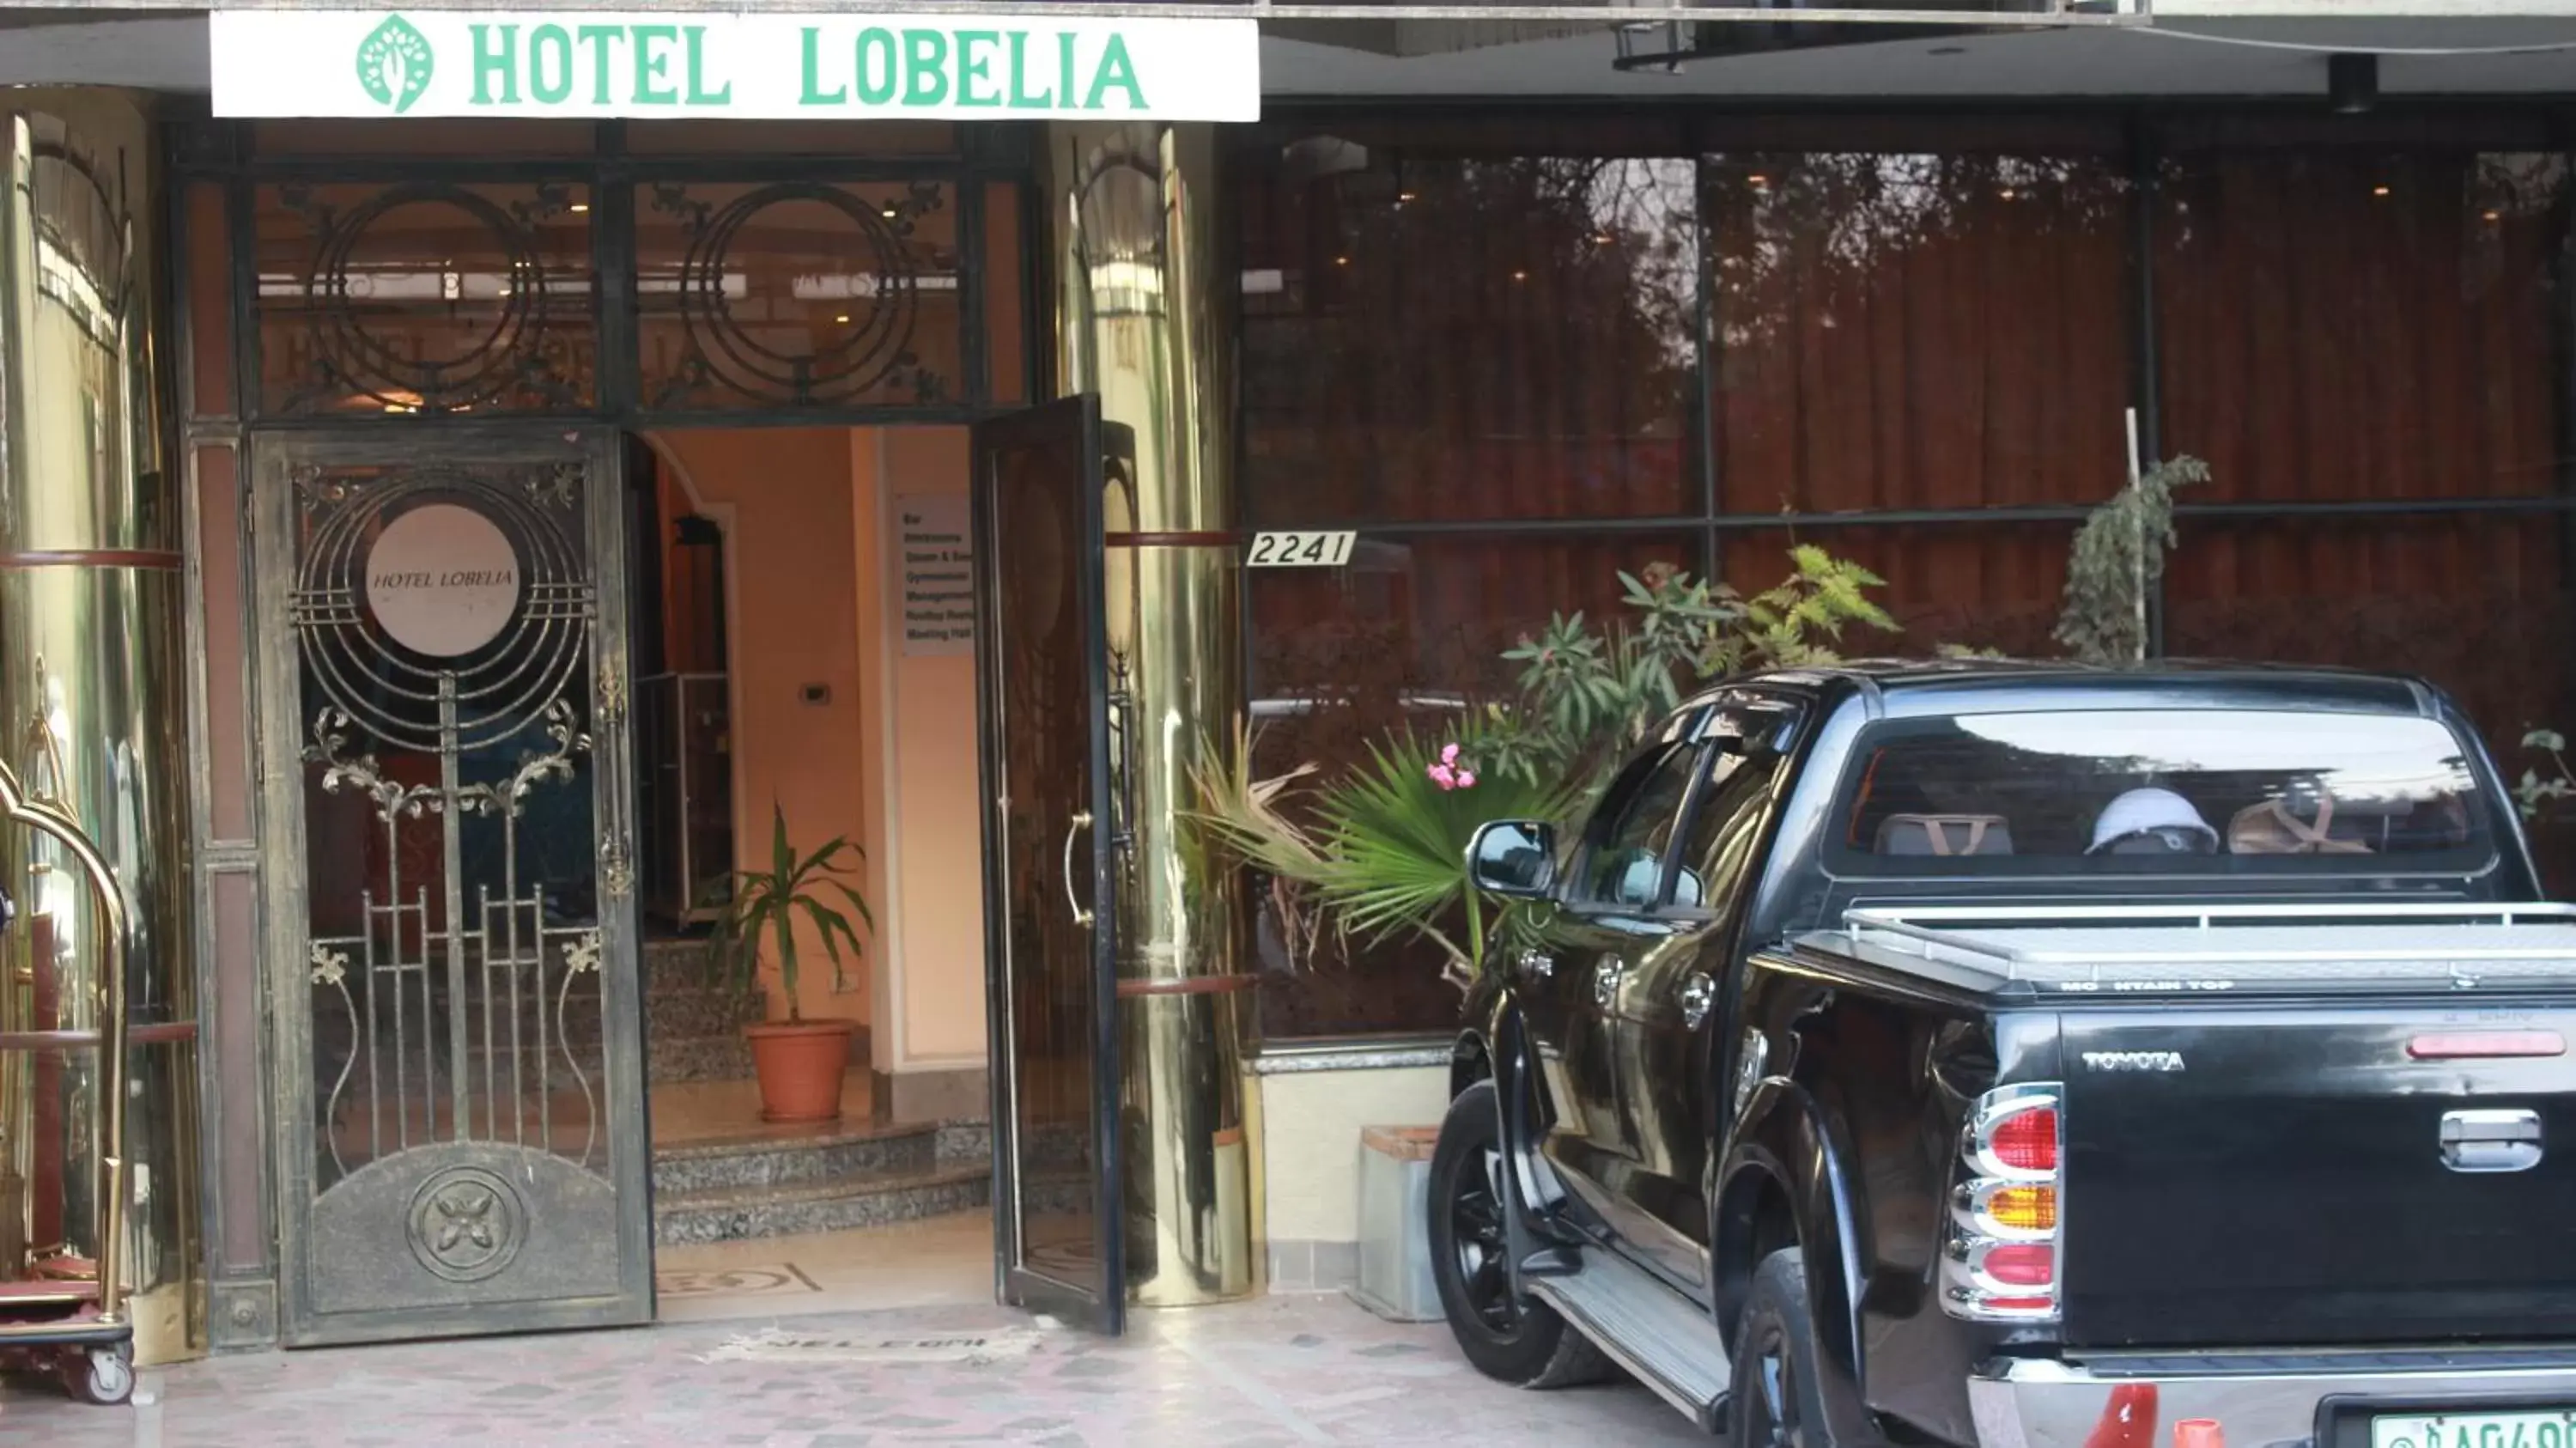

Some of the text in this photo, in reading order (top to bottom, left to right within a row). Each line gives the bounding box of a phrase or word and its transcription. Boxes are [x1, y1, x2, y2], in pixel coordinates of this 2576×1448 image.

[468, 23, 1151, 109] HOTEL LOBELIA
[1253, 534, 1346, 563] 2241
[374, 569, 513, 589] HOTEL LOBELIA
[2187, 981, 2235, 990] TOP
[2082, 1051, 2185, 1073] TOYOTA
